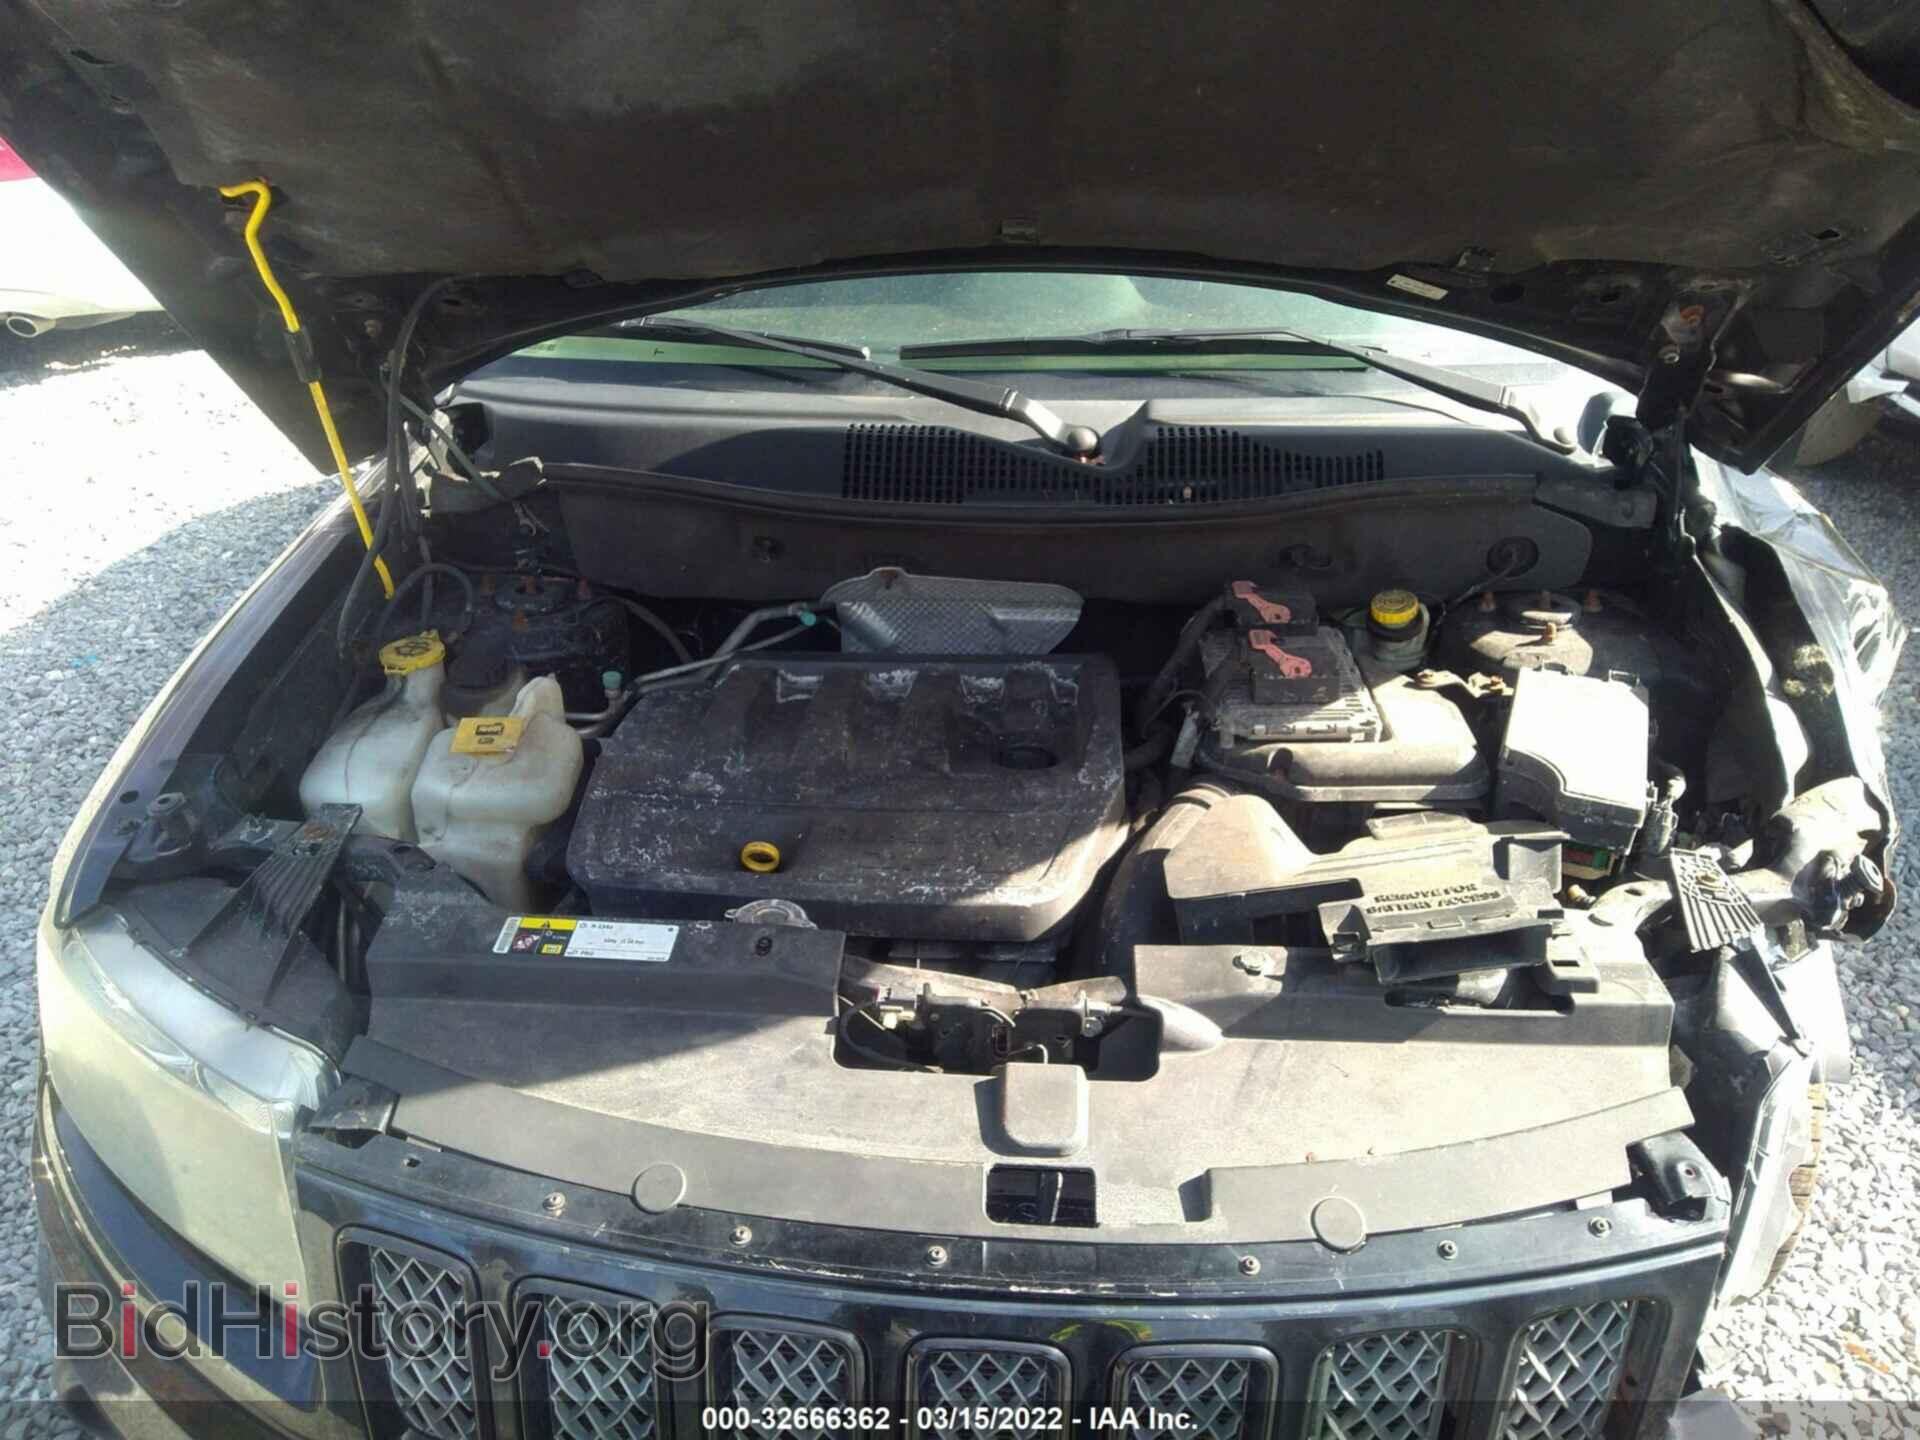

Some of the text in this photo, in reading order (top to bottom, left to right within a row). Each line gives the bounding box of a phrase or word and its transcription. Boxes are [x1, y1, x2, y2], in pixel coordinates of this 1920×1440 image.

[1443, 883, 1478, 896] FOR
[1365, 890, 1501, 914] BATTERY ACCESS
